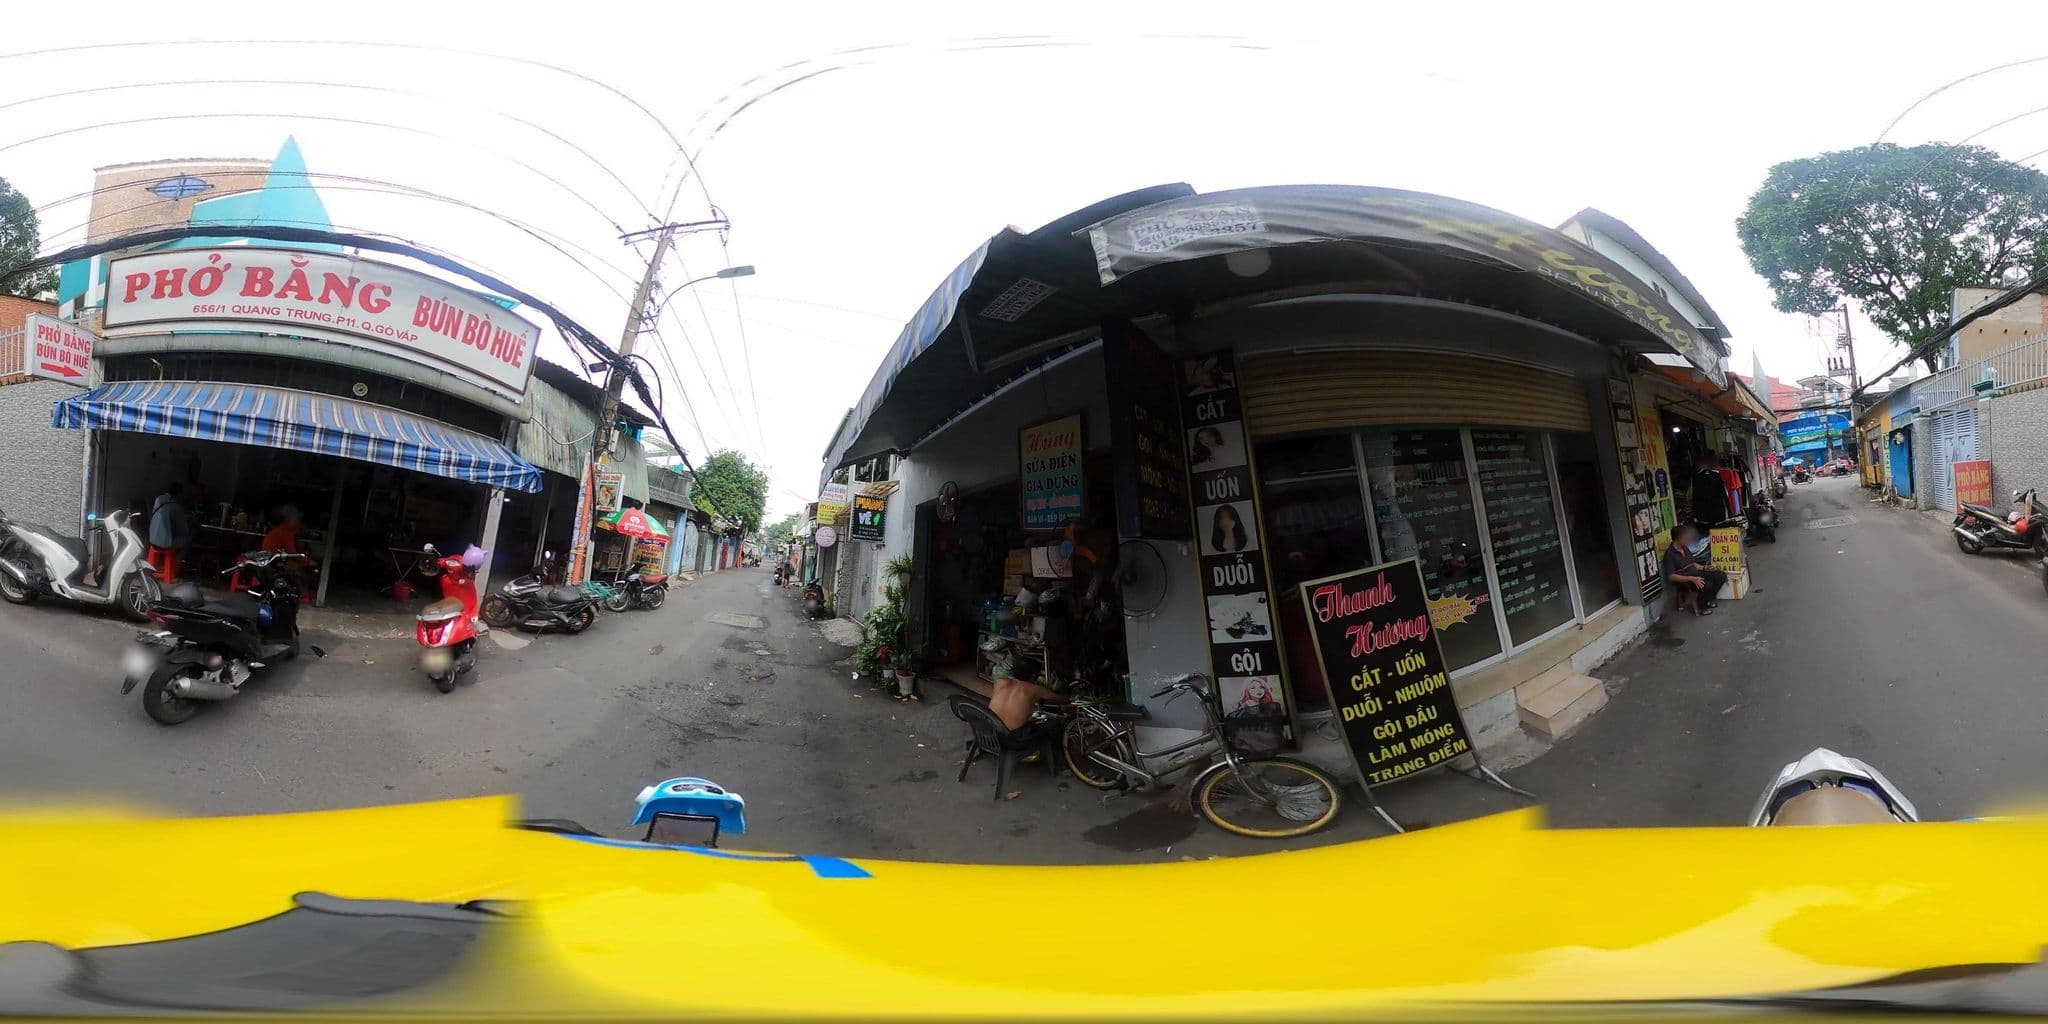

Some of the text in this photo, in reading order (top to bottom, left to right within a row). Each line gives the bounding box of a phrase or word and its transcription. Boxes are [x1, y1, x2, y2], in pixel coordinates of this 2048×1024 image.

[123, 253, 392, 314] PHỞ BẰNG
[192, 304, 226, 314] 656/1
[231, 304, 281, 316] QUANG
[37, 324, 91, 354] PHỞ BẰNG
[412, 295, 529, 369] BÚN BÒ HUẾ
[36, 342, 90, 369] BÚN BÒ HUẾ
[1196, 392, 1226, 421] CẮT
[1026, 452, 1077, 474] SỬA ĐIỆN
[1026, 474, 1080, 493] GIA DỤNG
[1205, 469, 1241, 500] UỐN
[1213, 554, 1255, 587] DUỖI
[1312, 571, 1396, 622] Thanh
[1345, 614, 1430, 658] Hương
[1231, 648, 1263, 676] GỘI
[1351, 664, 1381, 692] CẮT
[1395, 649, 1427, 676] UỐN
[1342, 692, 1384, 722] DUỖI
[1394, 672, 1447, 704] NHUỘM
[1373, 705, 1438, 739] GỘI ĐẦU
[1368, 723, 1455, 764] LÀM MÓNG
[1369, 738, 1468, 783] TRANG ĐIỂM
